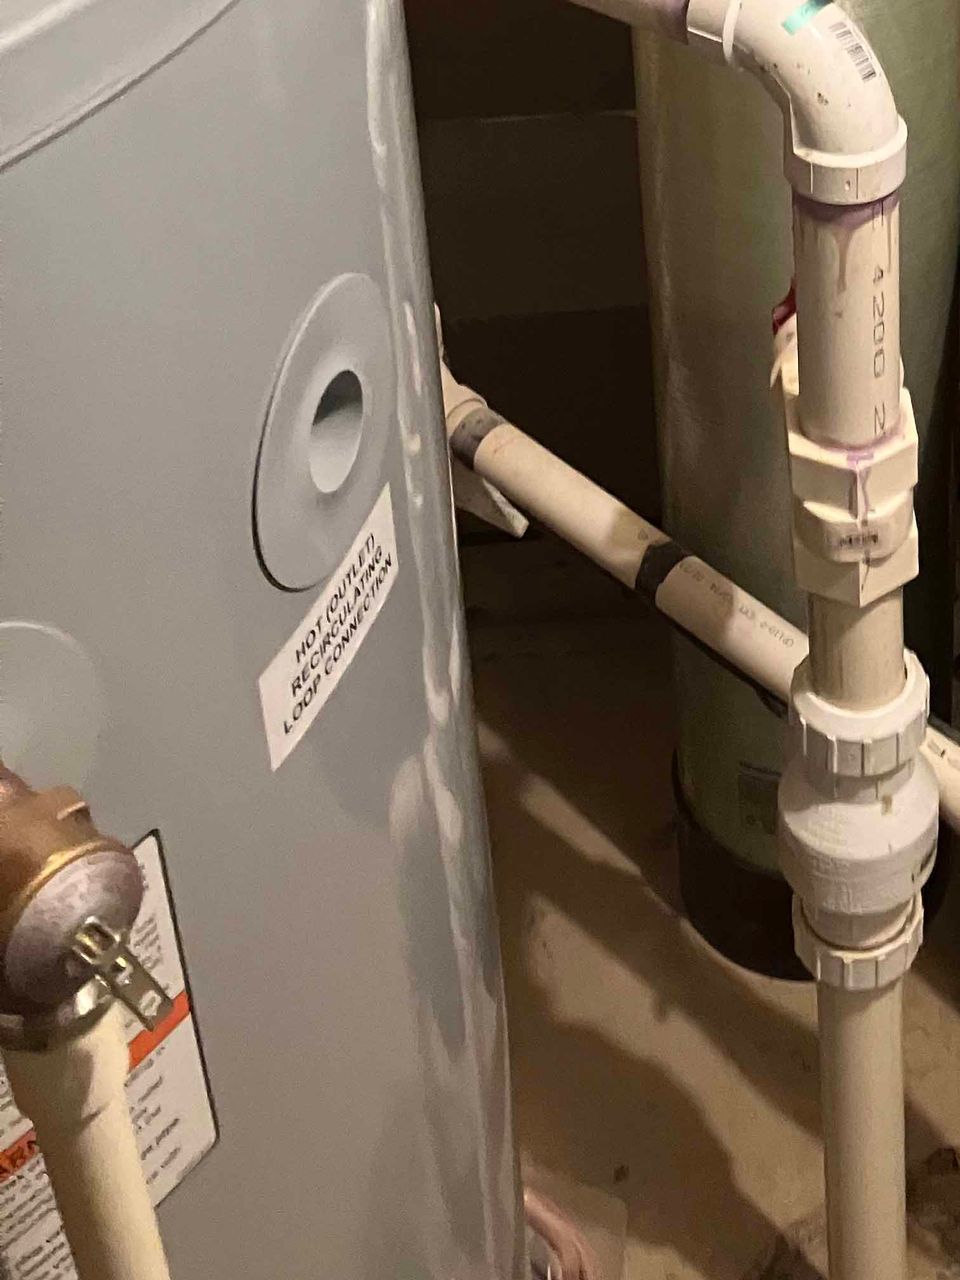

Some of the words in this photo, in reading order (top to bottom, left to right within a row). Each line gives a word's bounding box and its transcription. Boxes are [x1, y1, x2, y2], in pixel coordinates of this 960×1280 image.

[283, 675, 321, 734] LOOP
[324, 552, 393, 676] CONNECTION
[291, 545, 383, 697] RECIRCULATING
[295, 617, 322, 663] HOT
[326, 533, 375, 624] (OUTLET)
